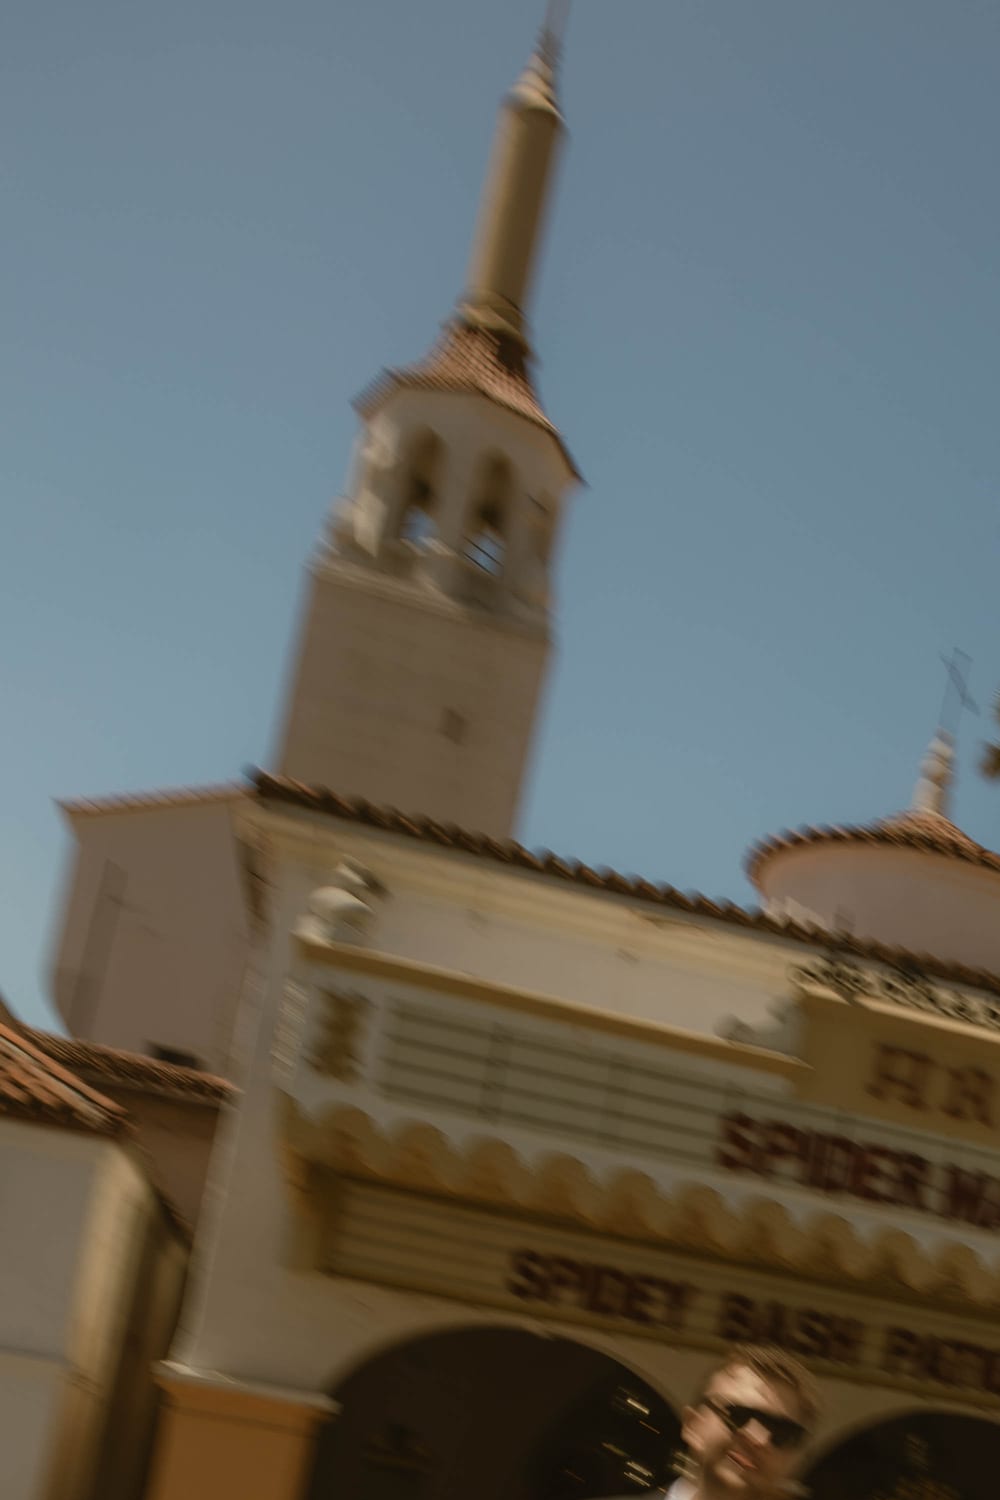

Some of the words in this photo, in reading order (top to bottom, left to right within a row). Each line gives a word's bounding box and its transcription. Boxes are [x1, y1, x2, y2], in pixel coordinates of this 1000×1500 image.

[716, 1110, 931, 1212] SPIDER
[506, 1249, 692, 1329] SPIDEY
[717, 1291, 864, 1363] BASH
